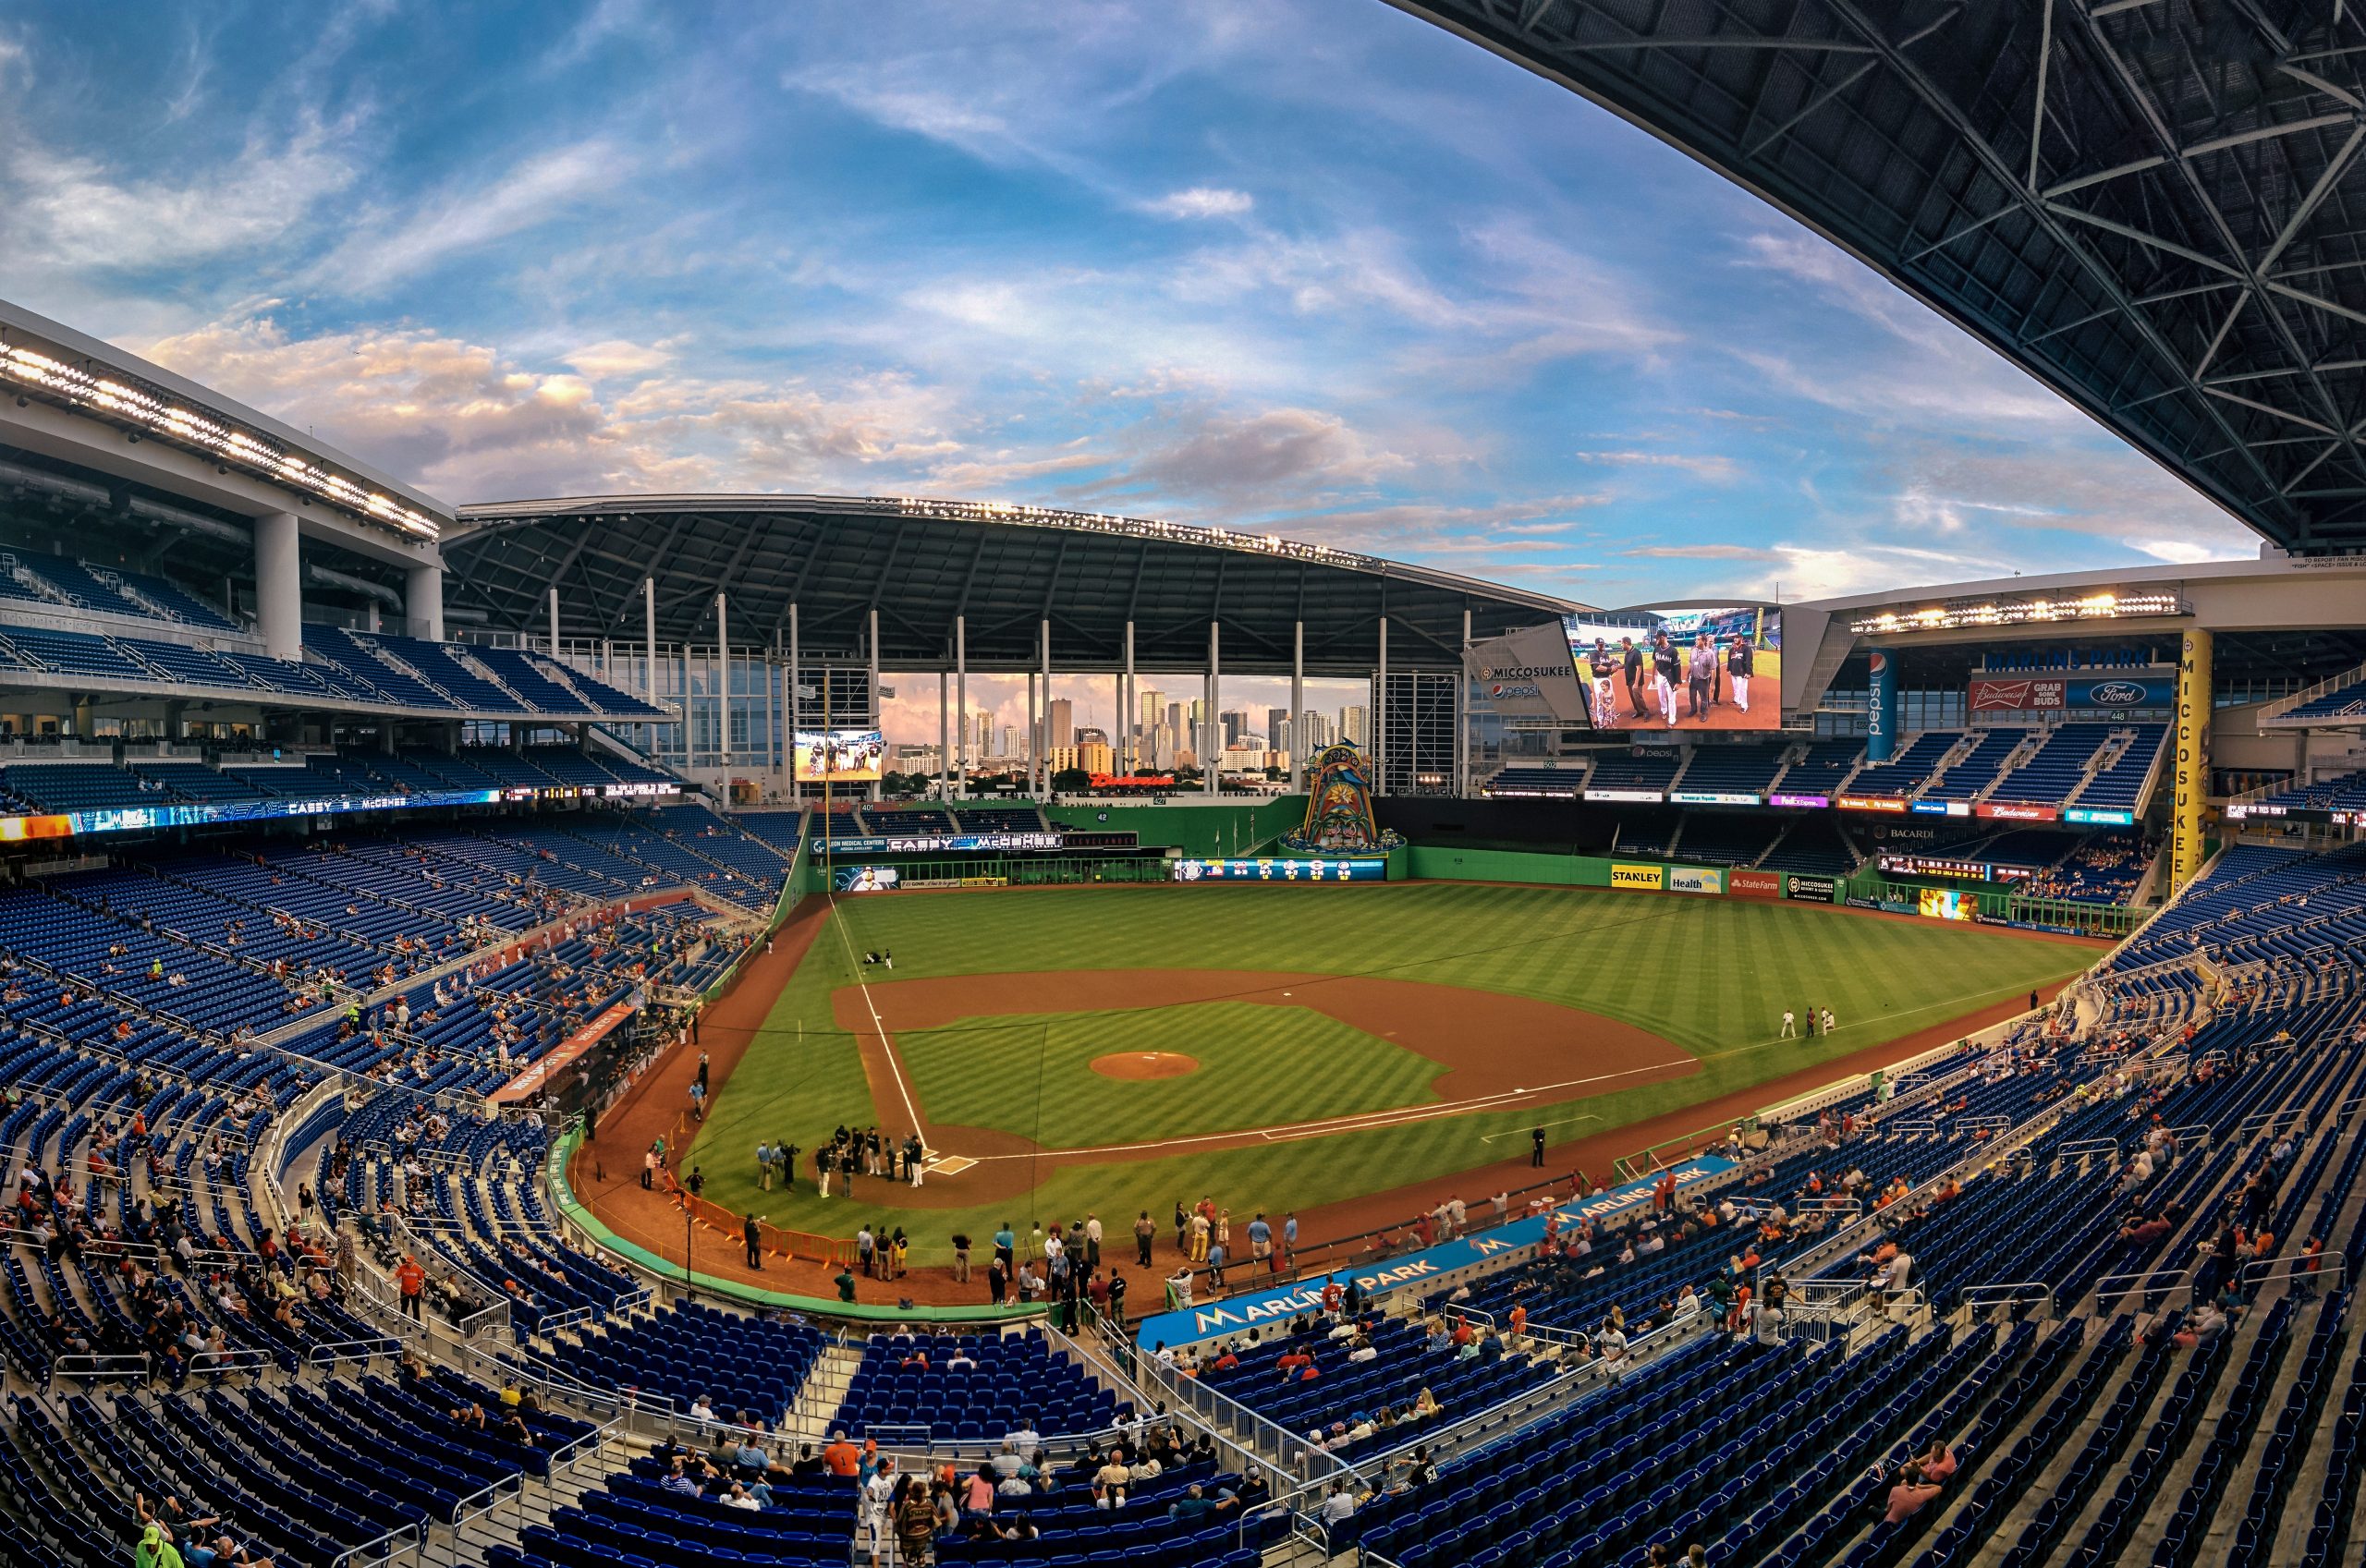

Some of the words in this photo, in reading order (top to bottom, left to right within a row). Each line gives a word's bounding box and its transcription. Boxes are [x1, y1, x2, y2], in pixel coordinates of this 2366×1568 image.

[1987, 650, 2080, 673] MARLINS
[2090, 649, 2150, 669] PARK
[1494, 665, 1571, 679] MICCOSUKEE
[1505, 684, 1539, 699] pepsi
[1975, 687, 2029, 701] Budweiser
[2034, 683, 2061, 692] GRAB
[2100, 685, 2135, 702] Ford
[1869, 681, 1883, 735] pepsi
[2034, 697, 2061, 706] BUDS
[2111, 712, 2125, 721] 448
[1646, 747, 1673, 759] pepsi
[289, 801, 332, 814] CASEY
[362, 797, 406, 809] McGEHEE
[1992, 806, 2040, 819] Budweiser
[2333, 813, 2346, 823] 7:01
[1065, 834, 1136, 846] CLEVELANDER
[1613, 871, 1660, 882] STANLEY
[1800, 881, 1834, 889] MICCOSUKEE
[1544, 1186, 1655, 1224] MARLINS
[1355, 1259, 1441, 1291] PARK
[1330, 1293, 1338, 1302] 33
[841, 1456, 846, 1466] 1
[1427, 1469, 1438, 1484] 24
